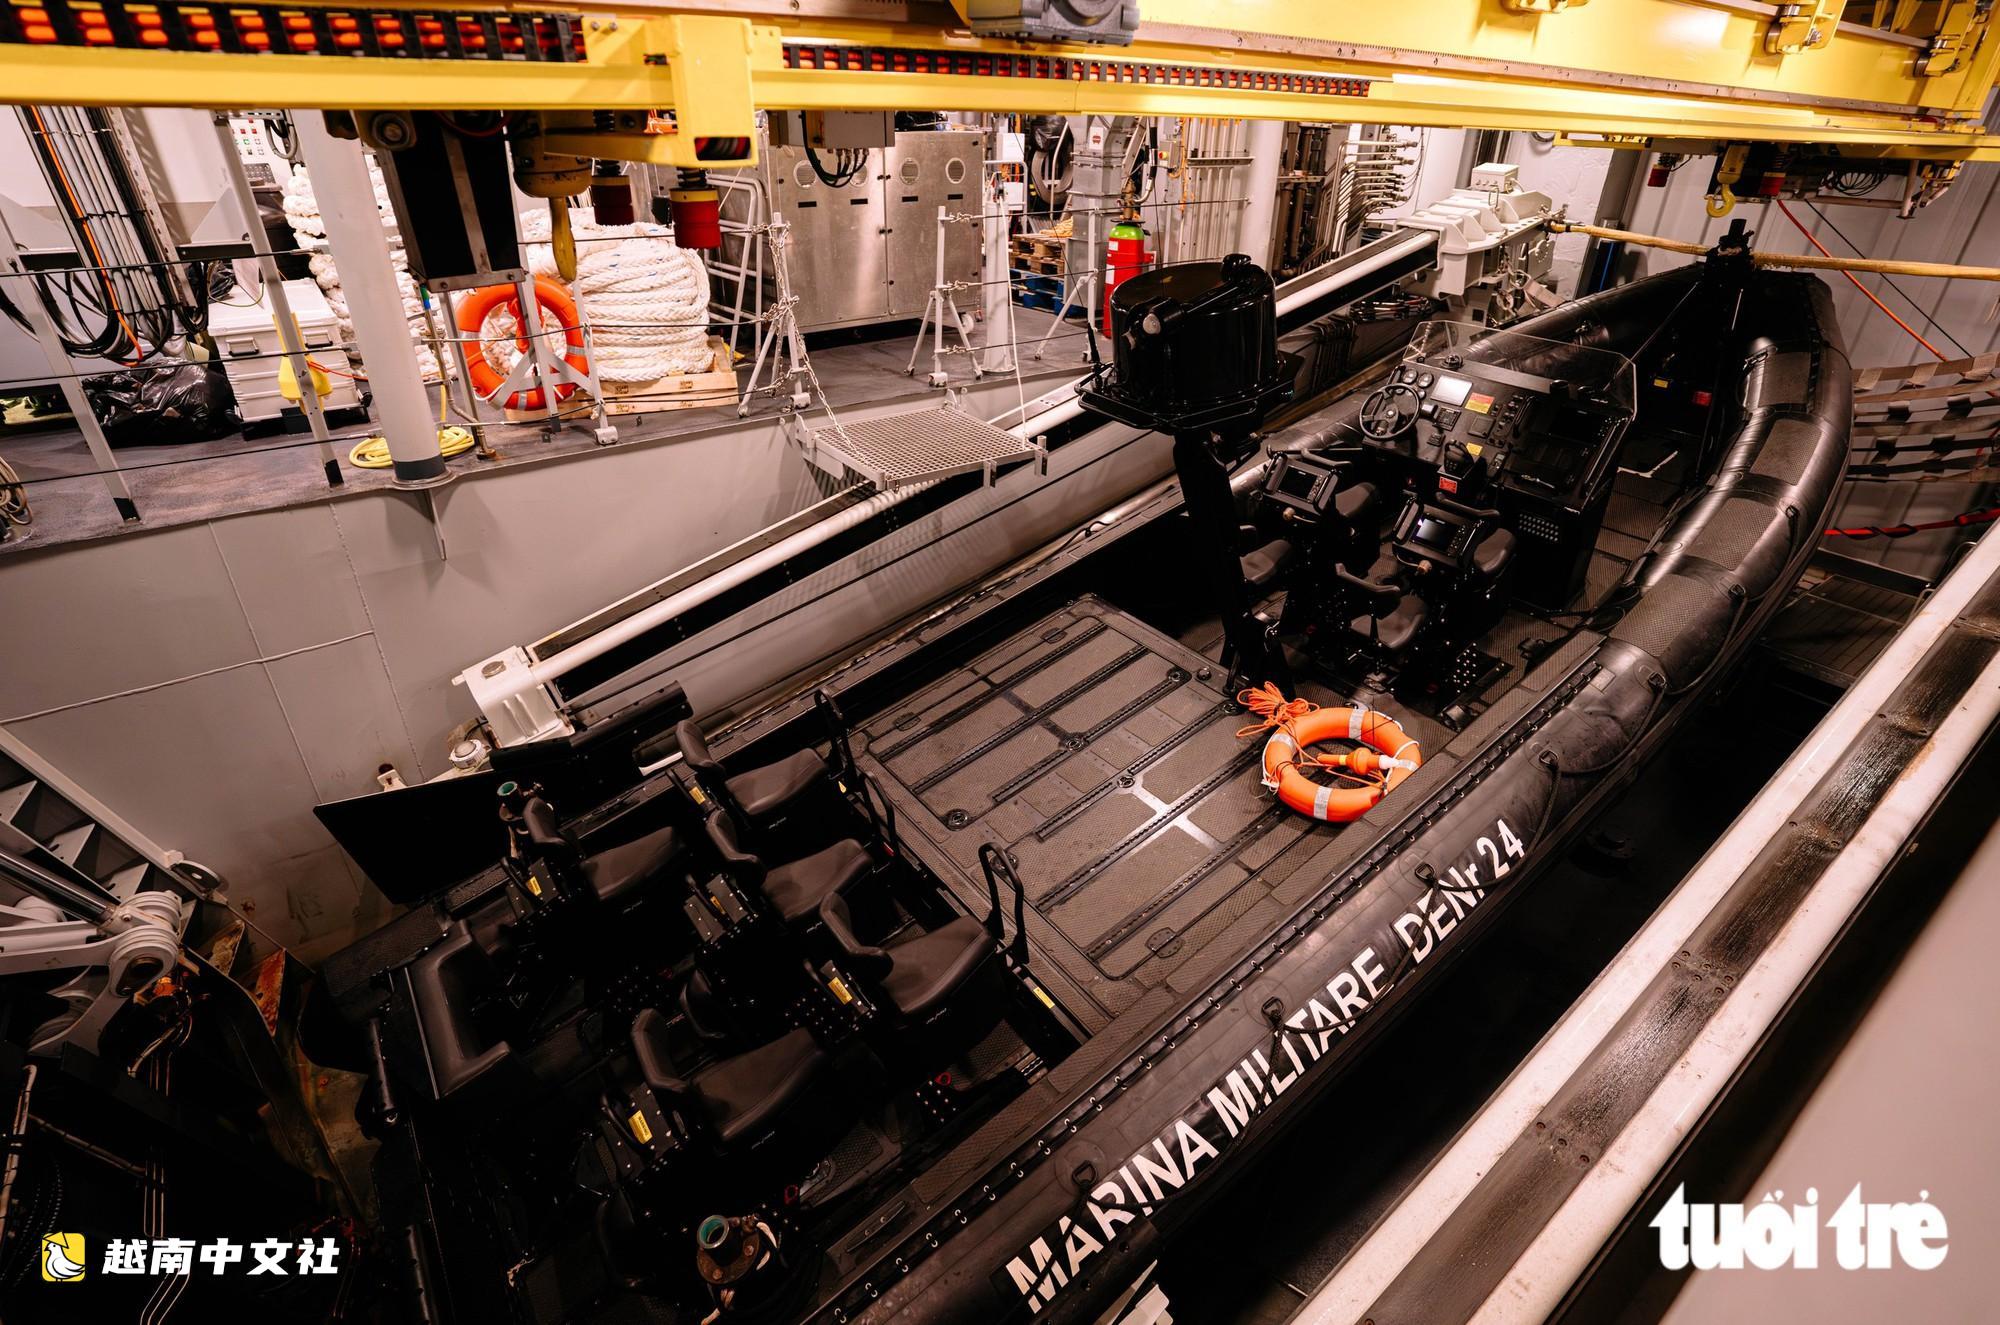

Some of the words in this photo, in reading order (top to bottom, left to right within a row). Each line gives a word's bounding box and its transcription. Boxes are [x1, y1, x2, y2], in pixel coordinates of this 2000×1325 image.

[1006, 1119, 1219, 1314] MARINA
[1207, 947, 1385, 1138] MILITARE
[1476, 819, 1525, 879] 24
